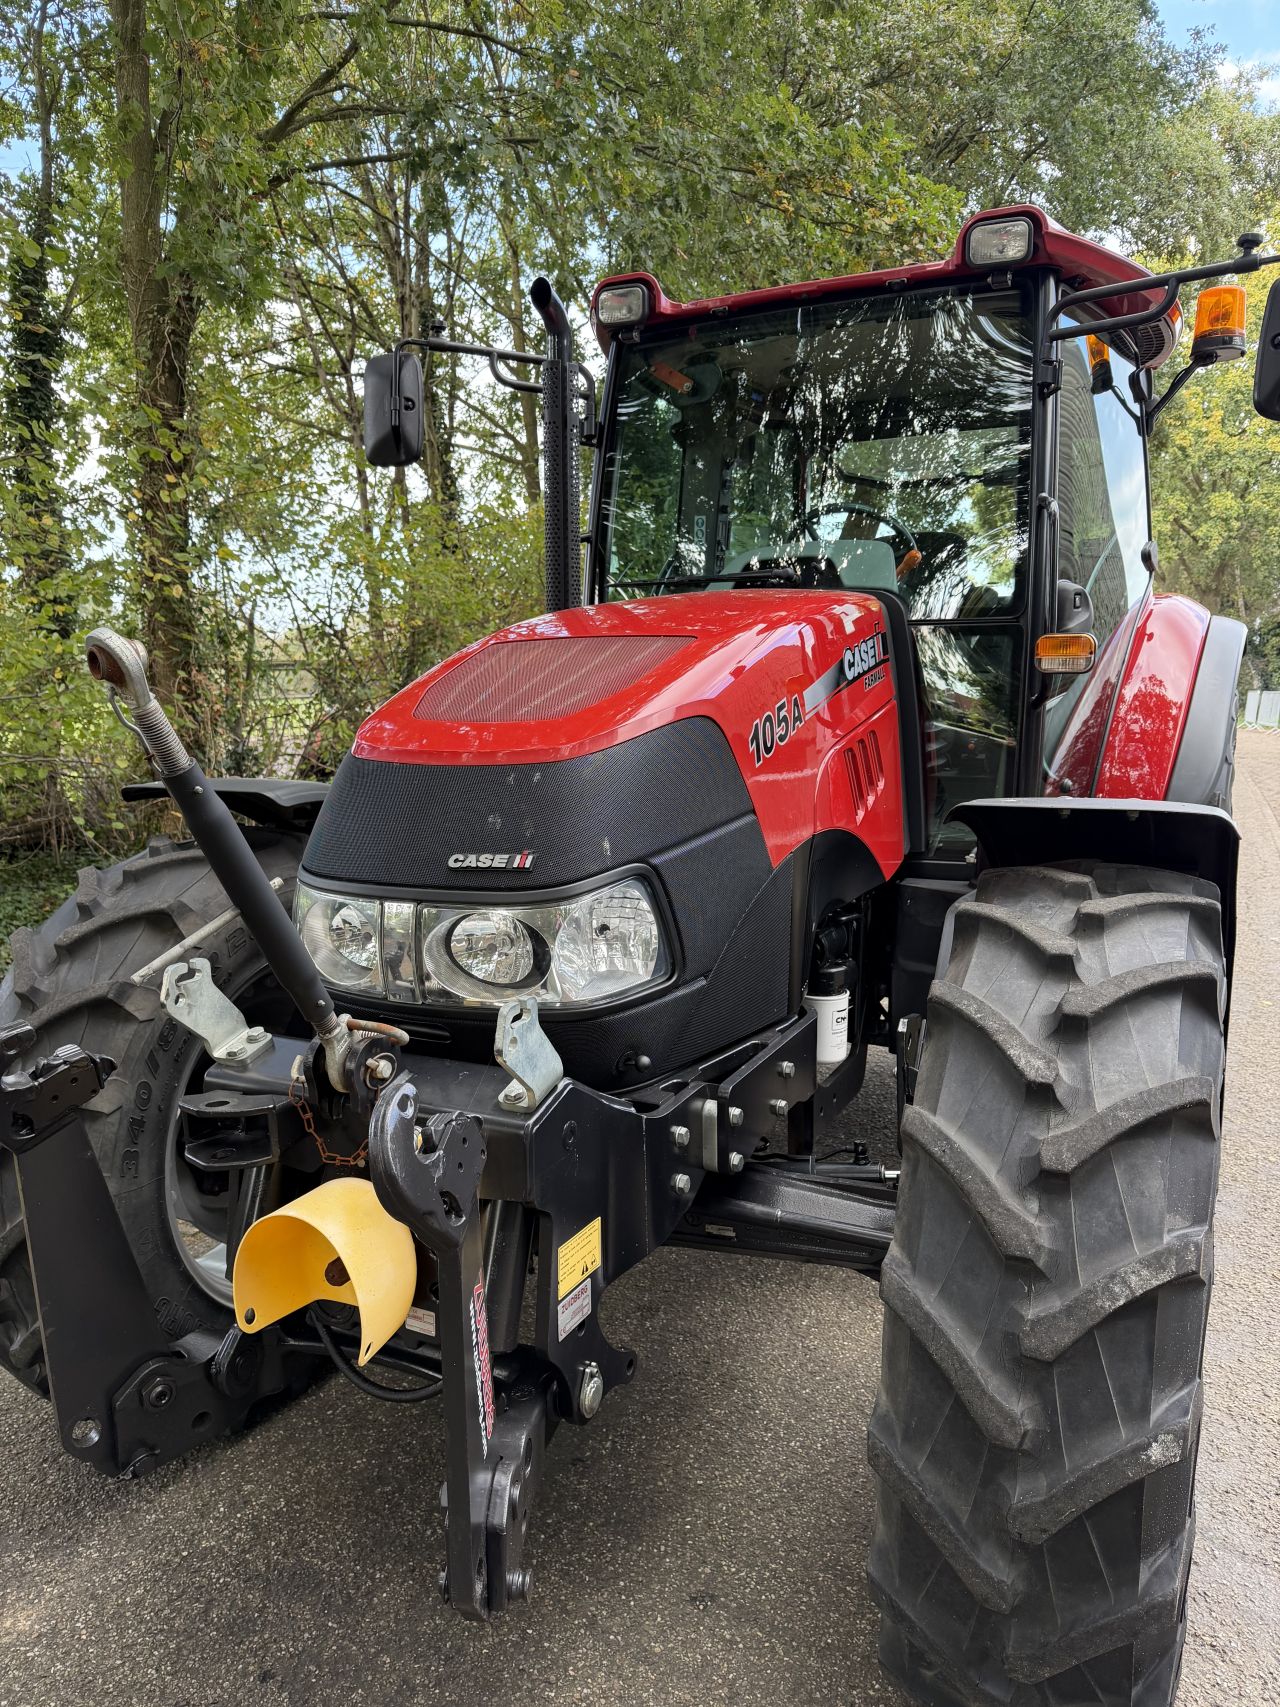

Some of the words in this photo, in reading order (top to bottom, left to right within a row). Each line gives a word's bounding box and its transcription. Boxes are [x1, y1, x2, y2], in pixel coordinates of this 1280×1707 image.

[844, 638, 876, 680] CASE
[864, 666, 885, 692] FARMALL
[749, 694, 804, 768] 105A
[447, 853, 509, 868] CASE
[120, 1018, 177, 1178] 340/8
[561, 1284, 589, 1315] ZUIDBERG
